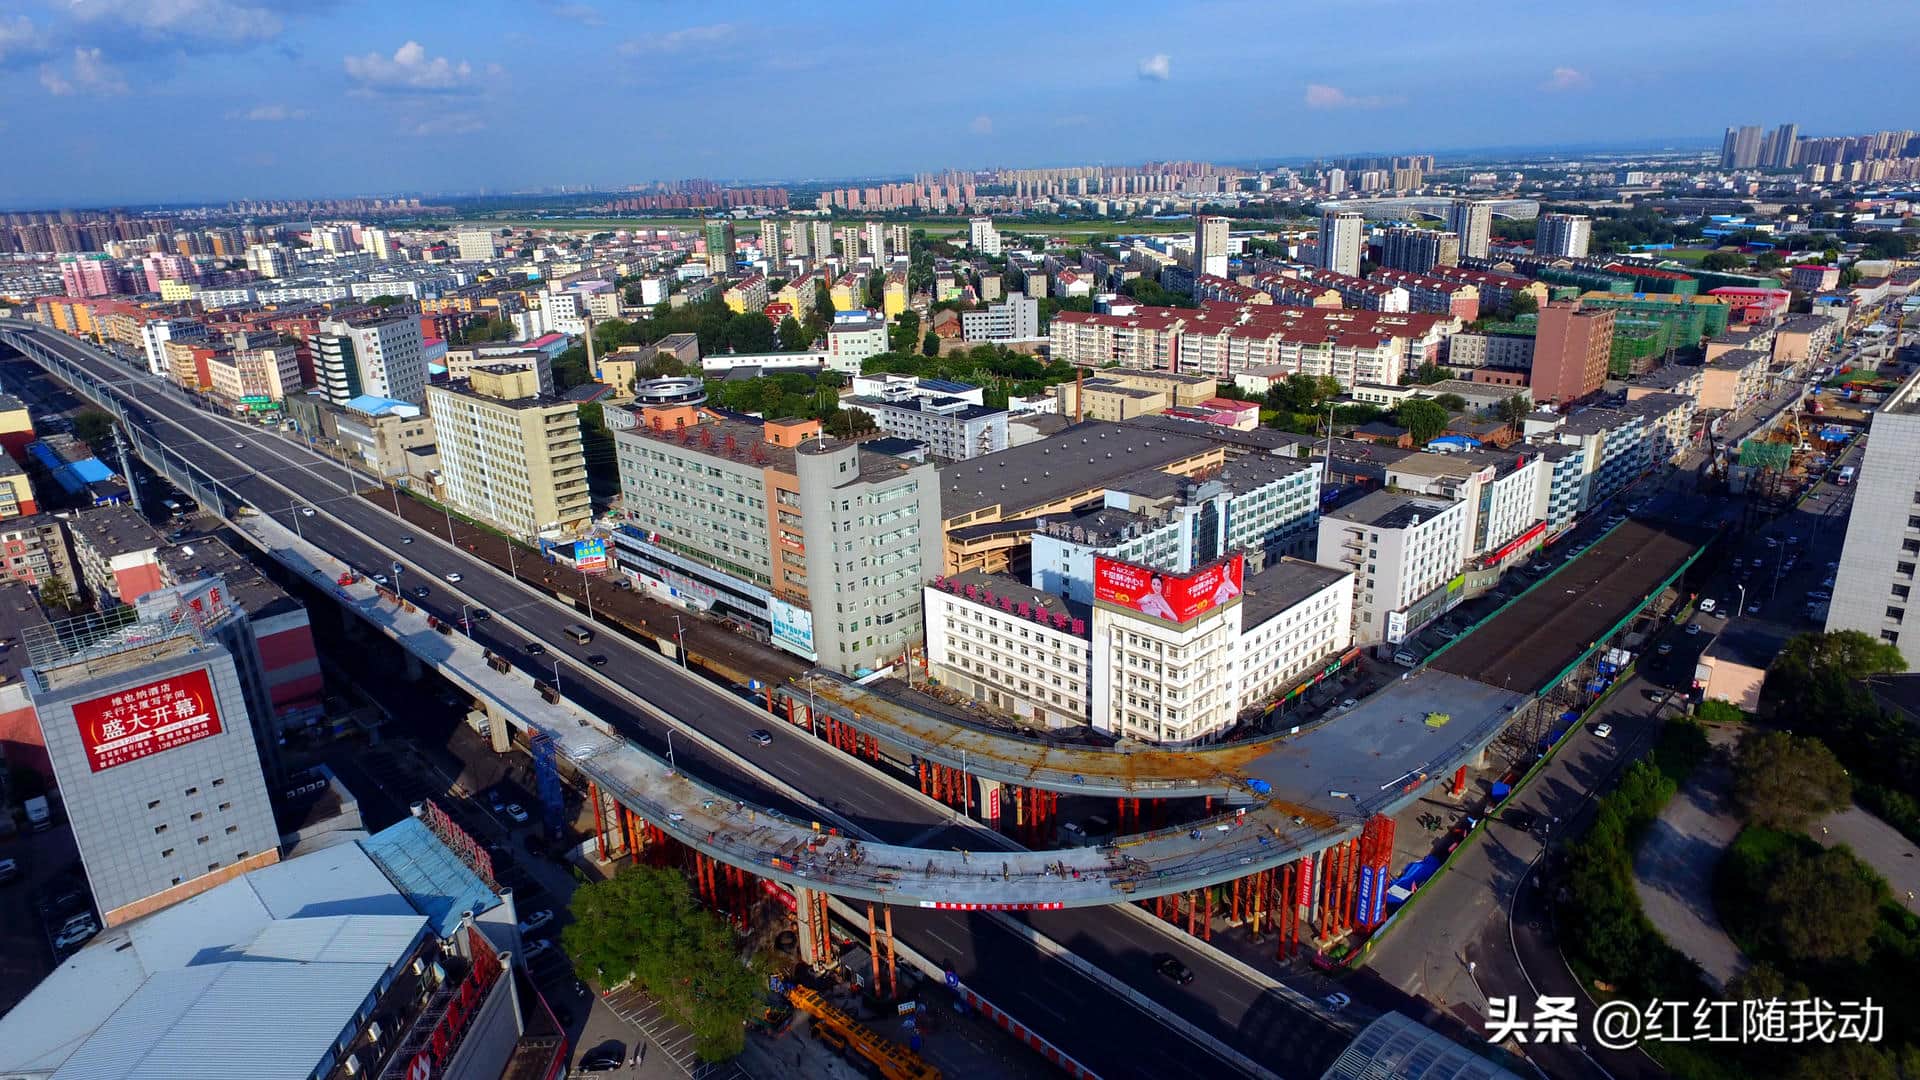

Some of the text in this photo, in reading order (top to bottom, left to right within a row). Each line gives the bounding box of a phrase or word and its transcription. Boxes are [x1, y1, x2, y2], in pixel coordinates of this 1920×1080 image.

[102, 690, 185, 720] 天行大厦写字间
[112, 683, 170, 706] 维也纳酒店
[102, 698, 196, 741] 盛大开幕
